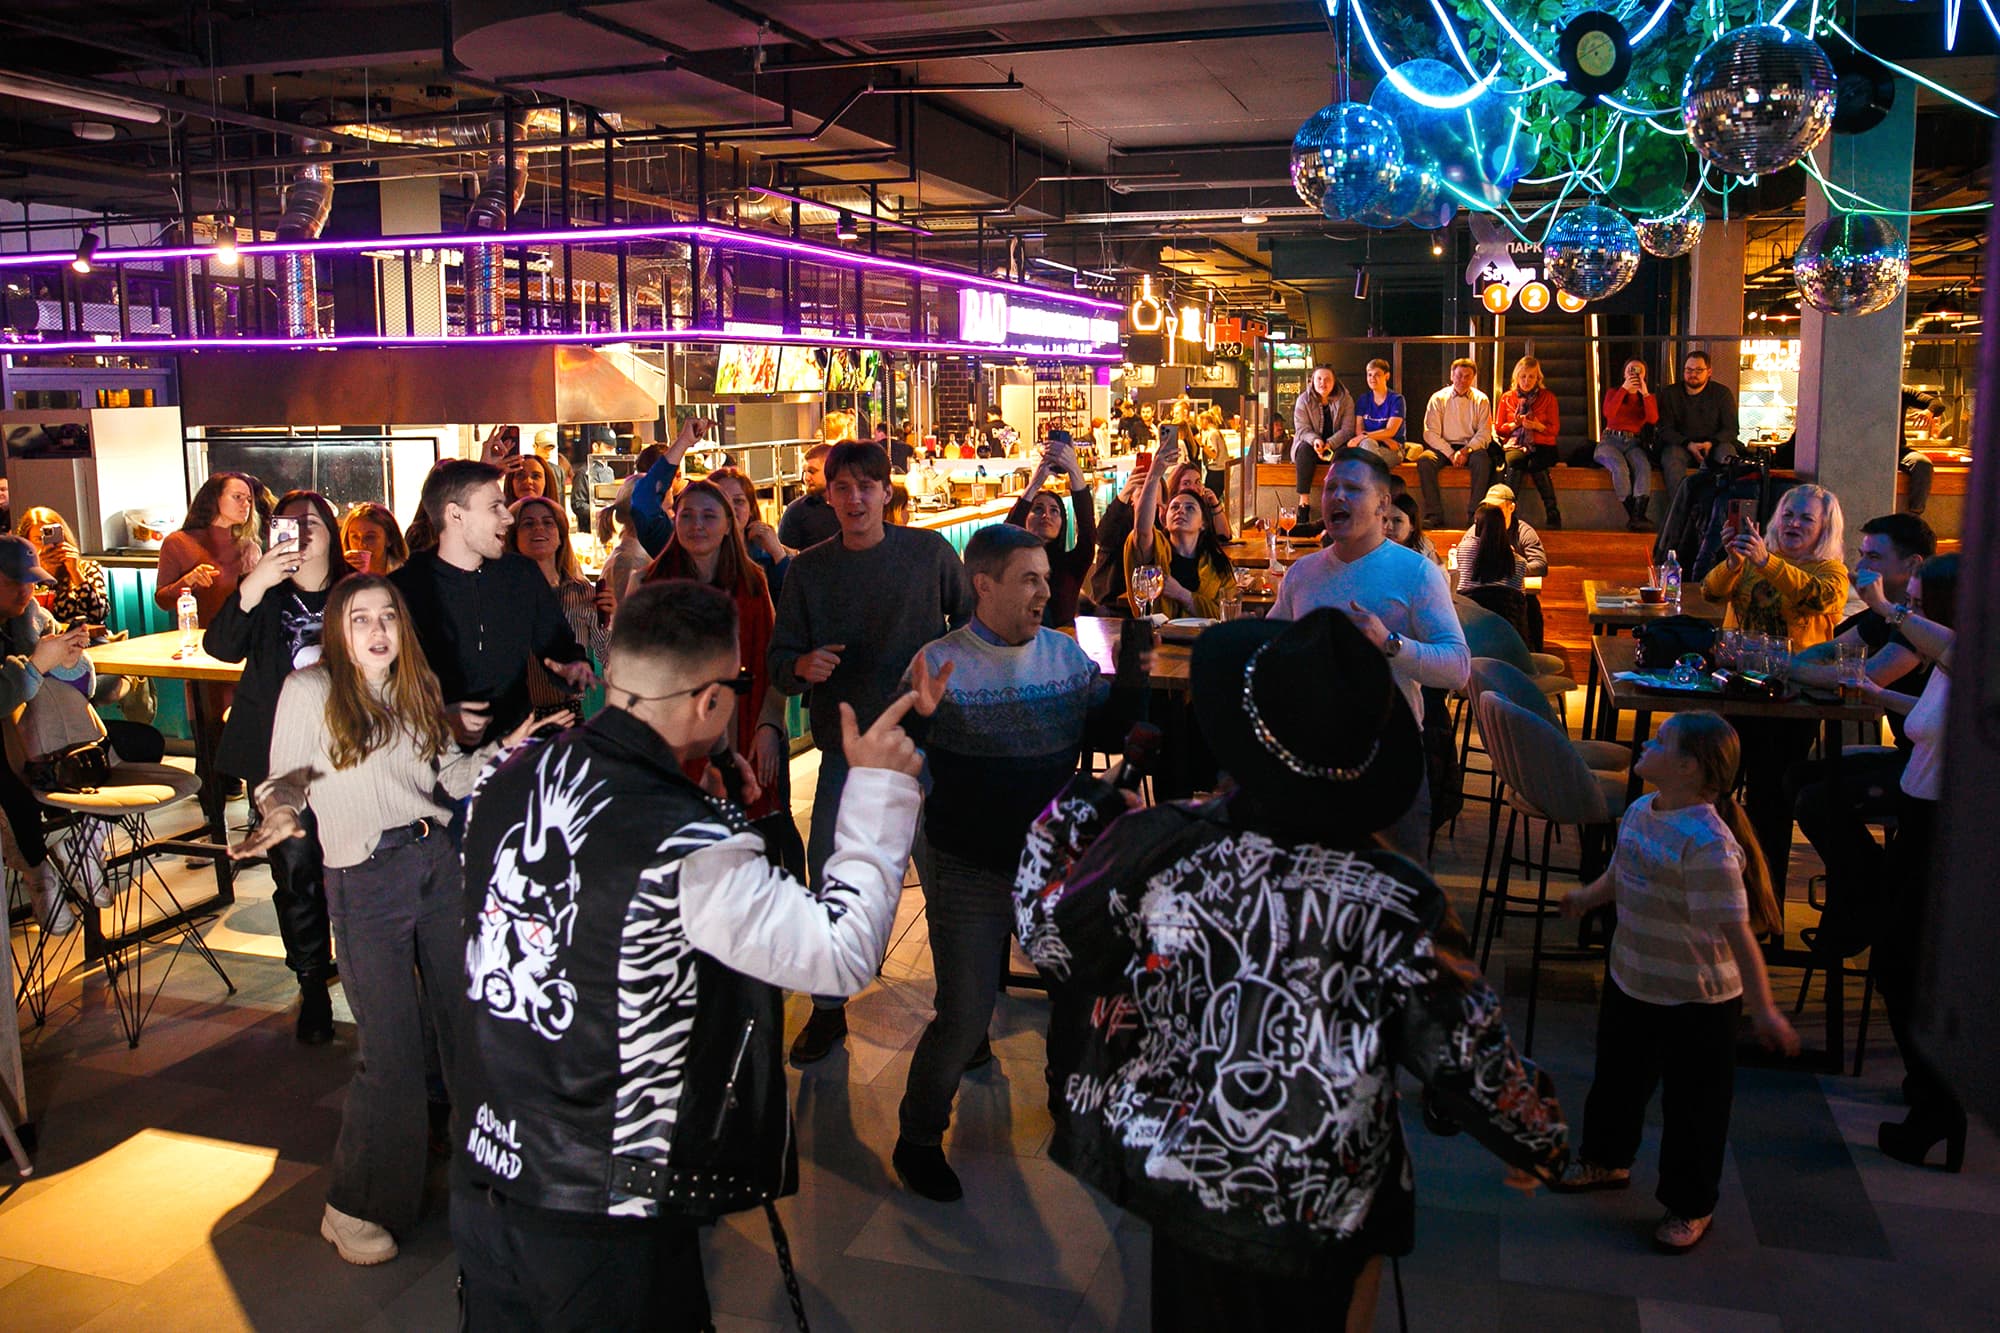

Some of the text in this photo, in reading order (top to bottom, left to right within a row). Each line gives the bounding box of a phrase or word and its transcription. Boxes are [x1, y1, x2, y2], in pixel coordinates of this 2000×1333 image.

[1299, 887, 1404, 968] NOW
[1320, 960, 1372, 1020] OR
[467, 1127, 523, 1180] NOMAD
